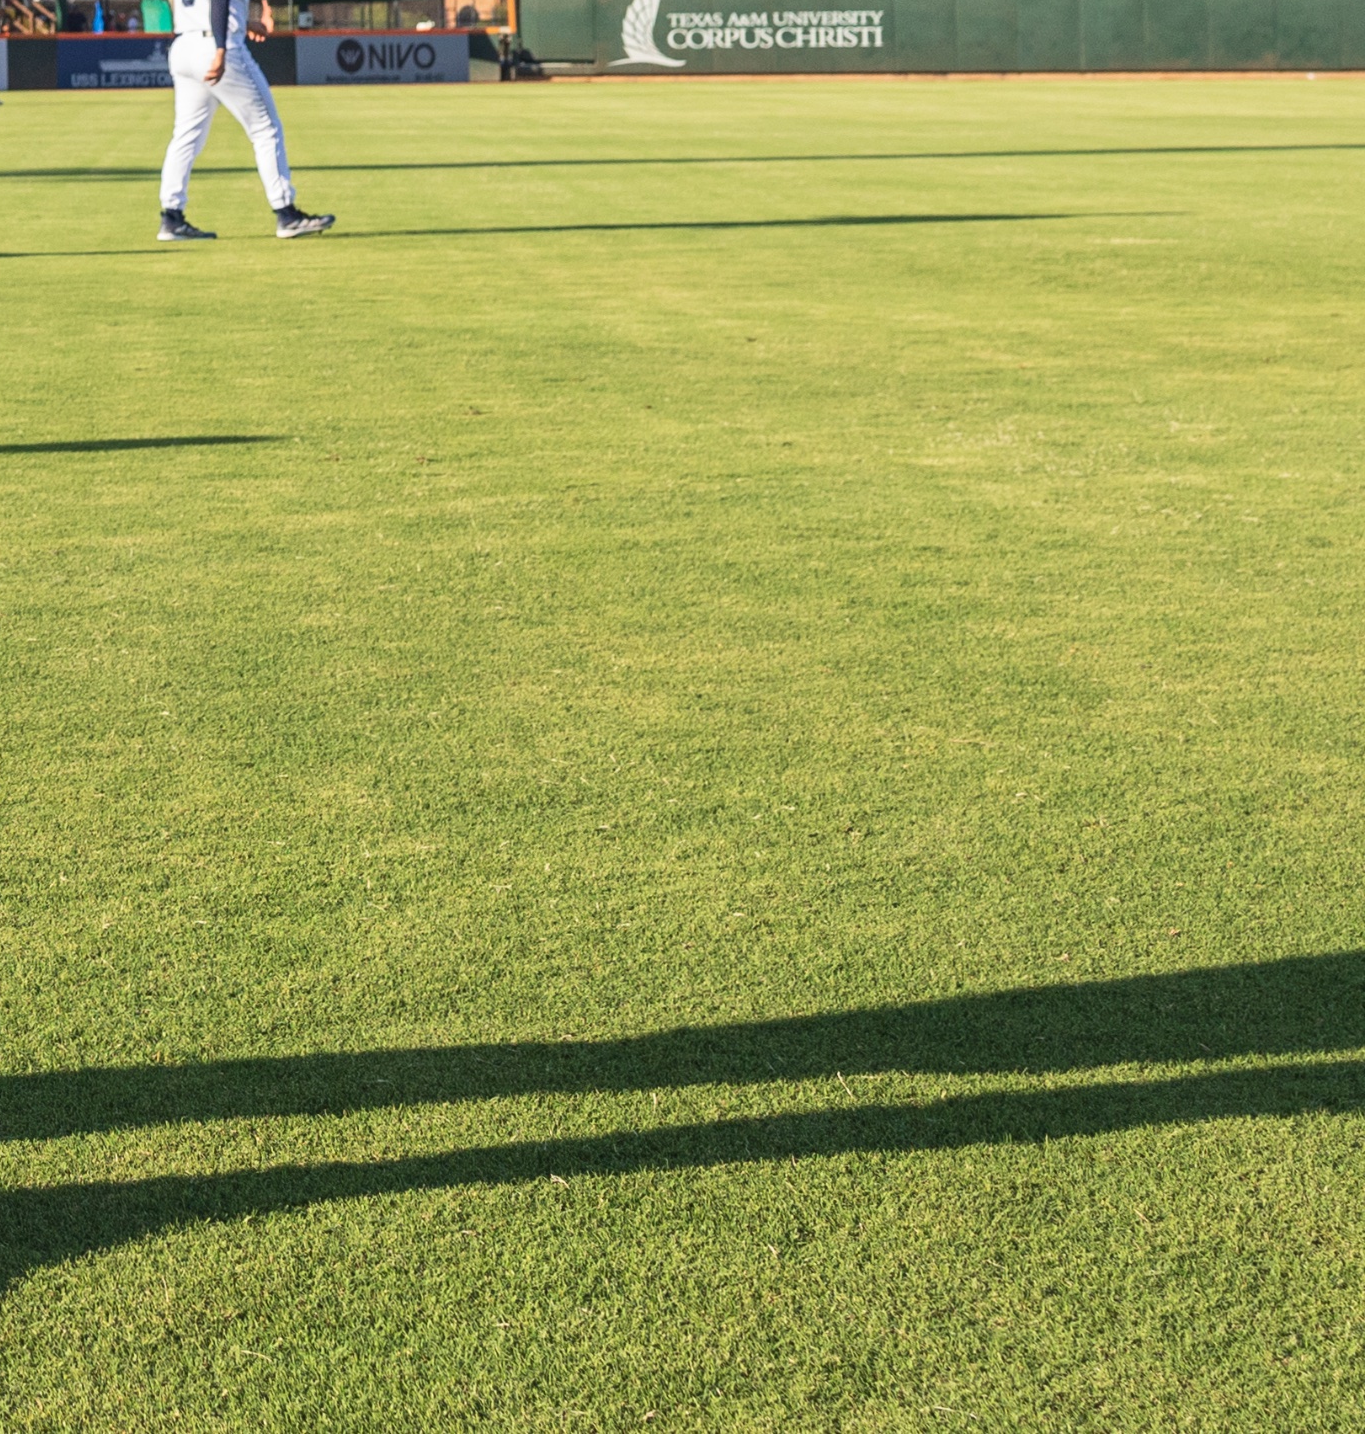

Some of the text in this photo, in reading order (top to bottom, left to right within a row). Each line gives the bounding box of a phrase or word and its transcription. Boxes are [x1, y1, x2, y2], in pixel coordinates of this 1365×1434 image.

[667, 10, 884, 28] TEXAS A&M UNIVERSITY
[667, 26, 883, 49] CORPUS CHRISTI
[368, 42, 436, 69] NIVO
[71, 72, 99, 87] USS
